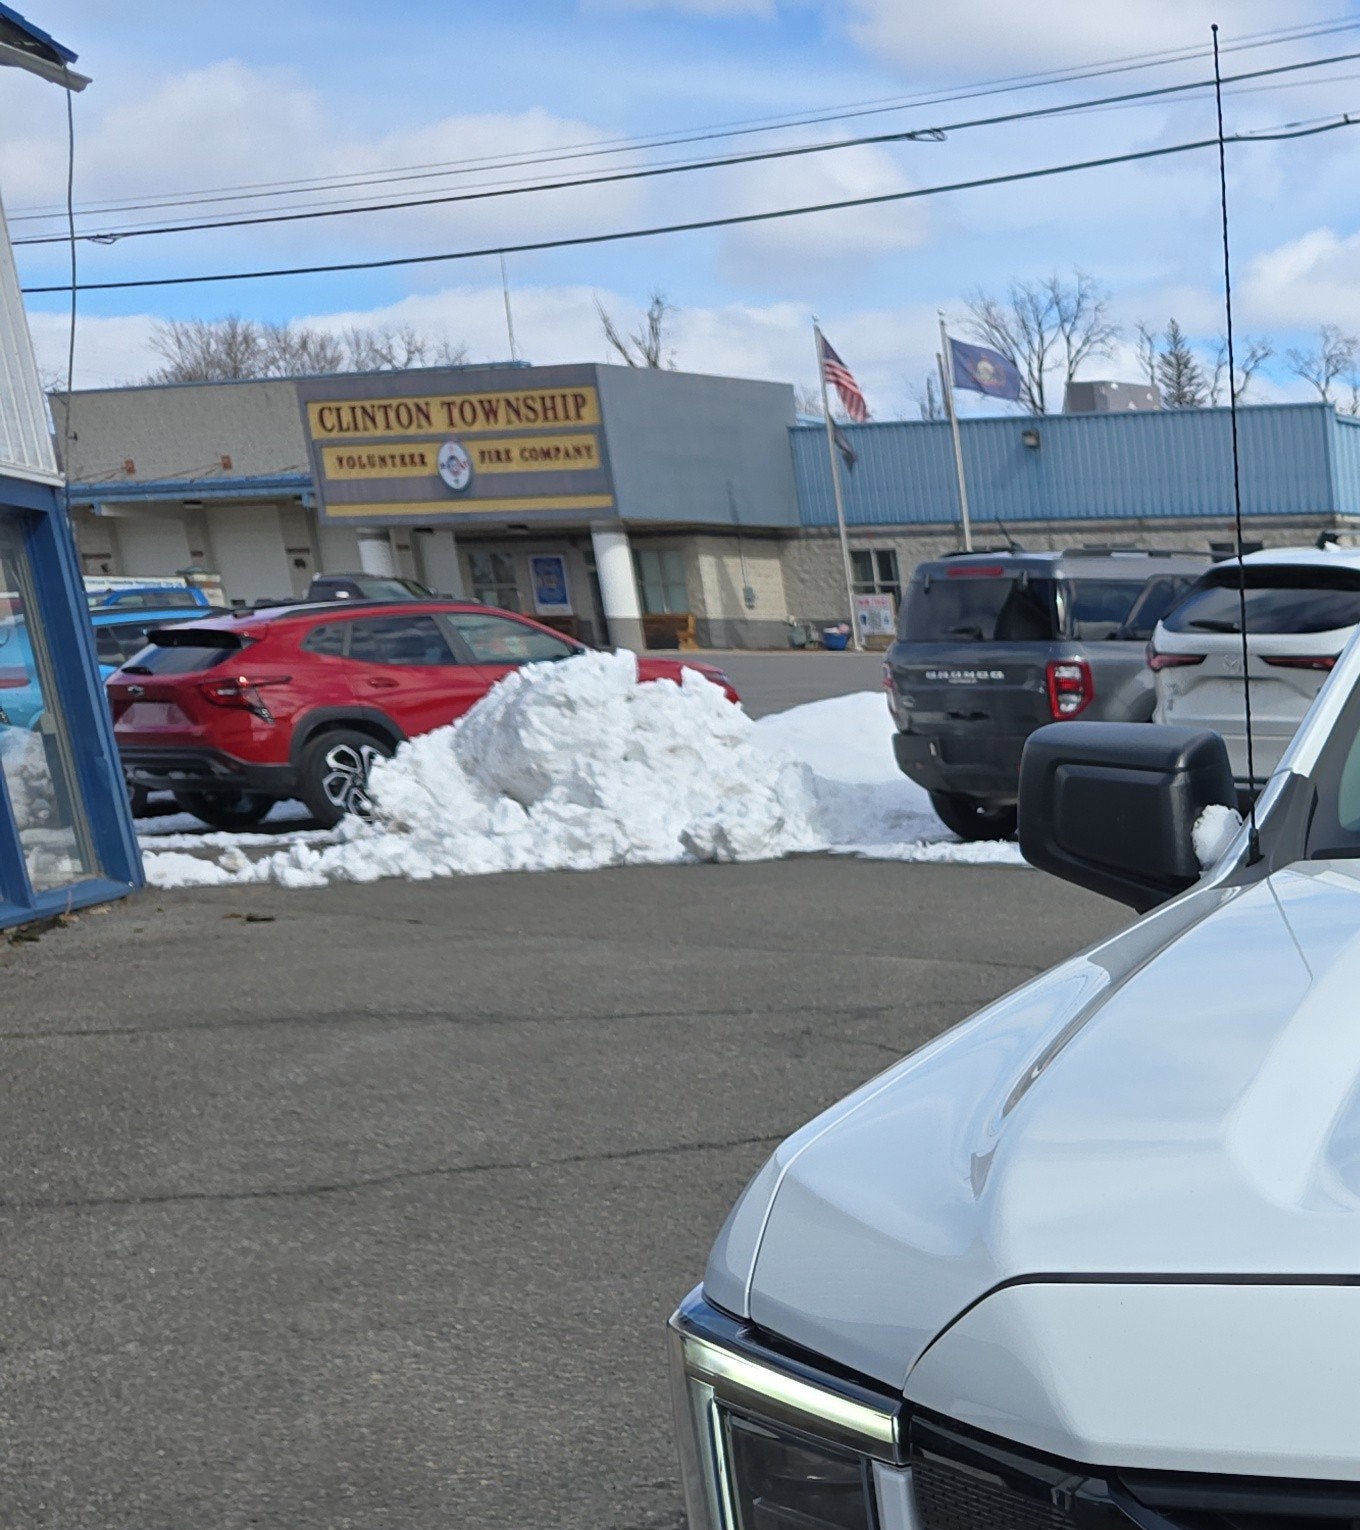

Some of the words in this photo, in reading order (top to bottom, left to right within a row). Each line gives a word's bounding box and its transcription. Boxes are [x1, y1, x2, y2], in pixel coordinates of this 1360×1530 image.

[317, 401, 433, 433] CLINTON
[440, 392, 587, 428] TOWNSHIP
[336, 452, 428, 470] VOLUNTEER
[478, 447, 513, 465] FIRE
[520, 444, 593, 462] COMPANY
